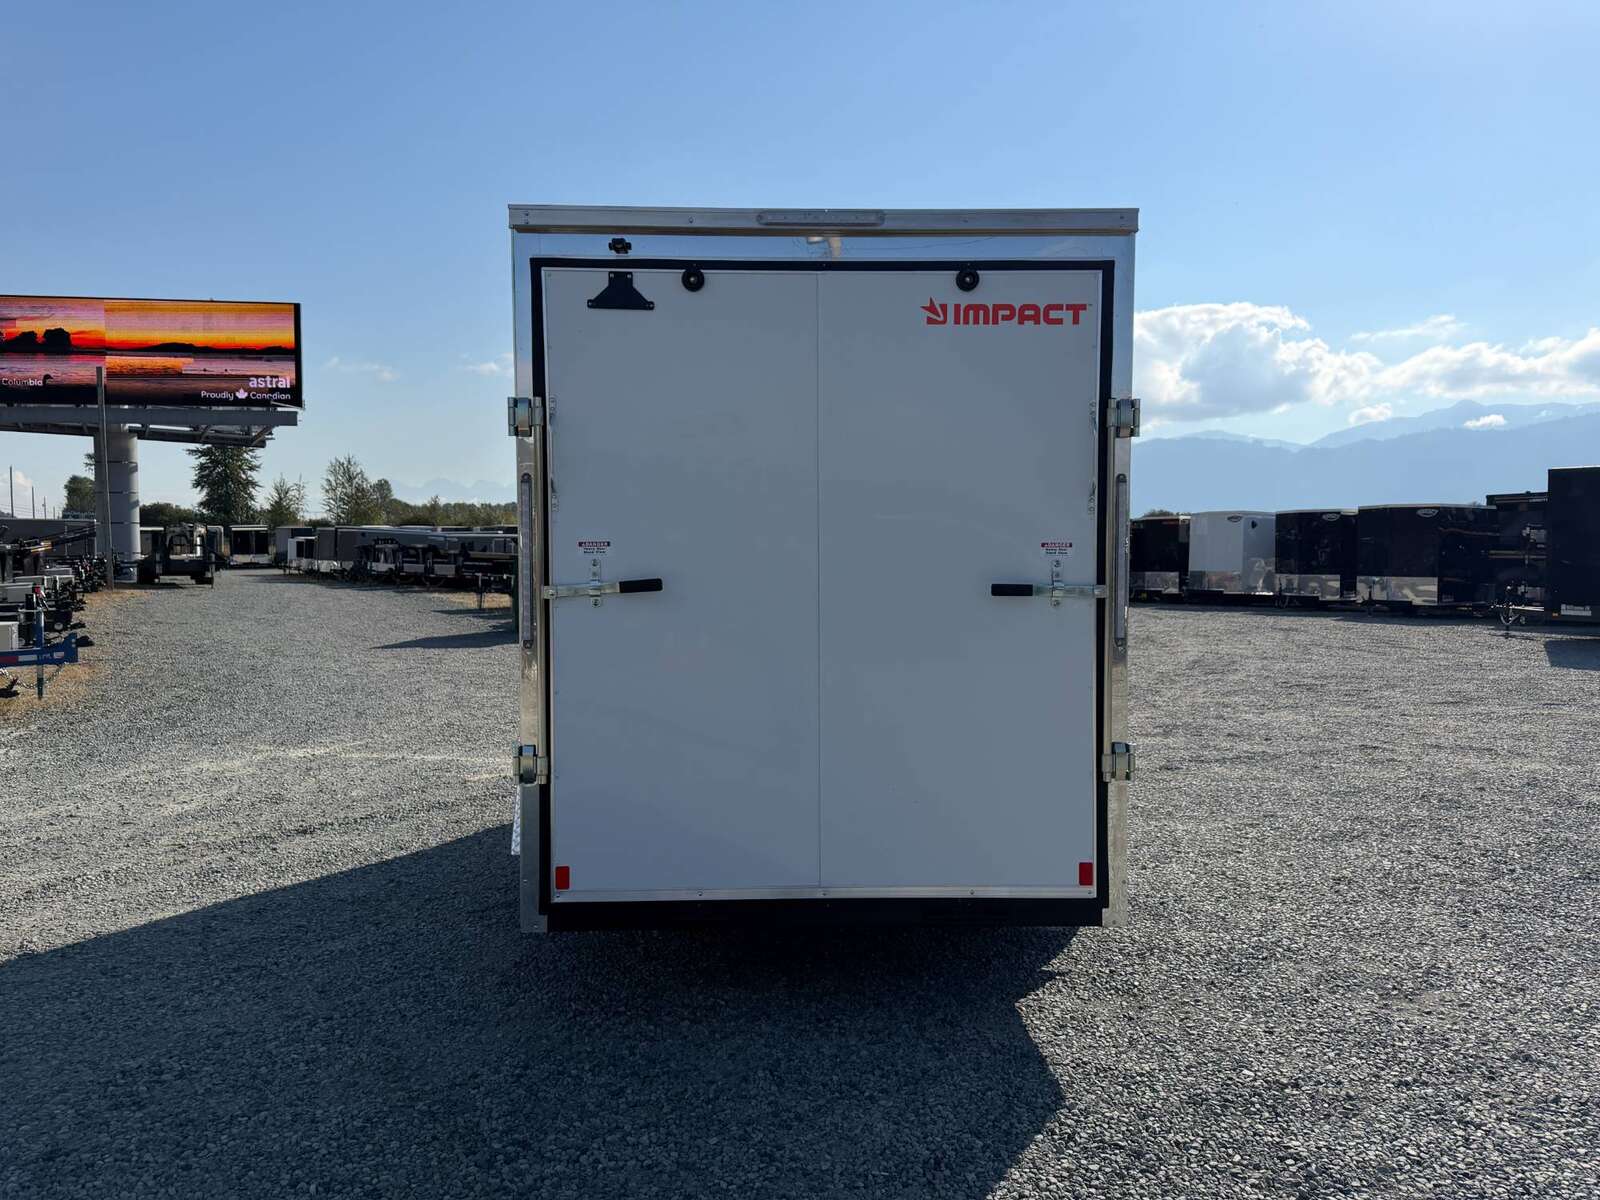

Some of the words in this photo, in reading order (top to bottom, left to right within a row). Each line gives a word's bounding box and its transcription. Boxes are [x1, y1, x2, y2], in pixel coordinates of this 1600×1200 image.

[953, 303, 1088, 325] IMPACT
[1, 377, 43, 386] Columbia
[249, 376, 291, 388] astral
[200, 390, 234, 400] Proudly
[250, 391, 291, 400] Canadian
